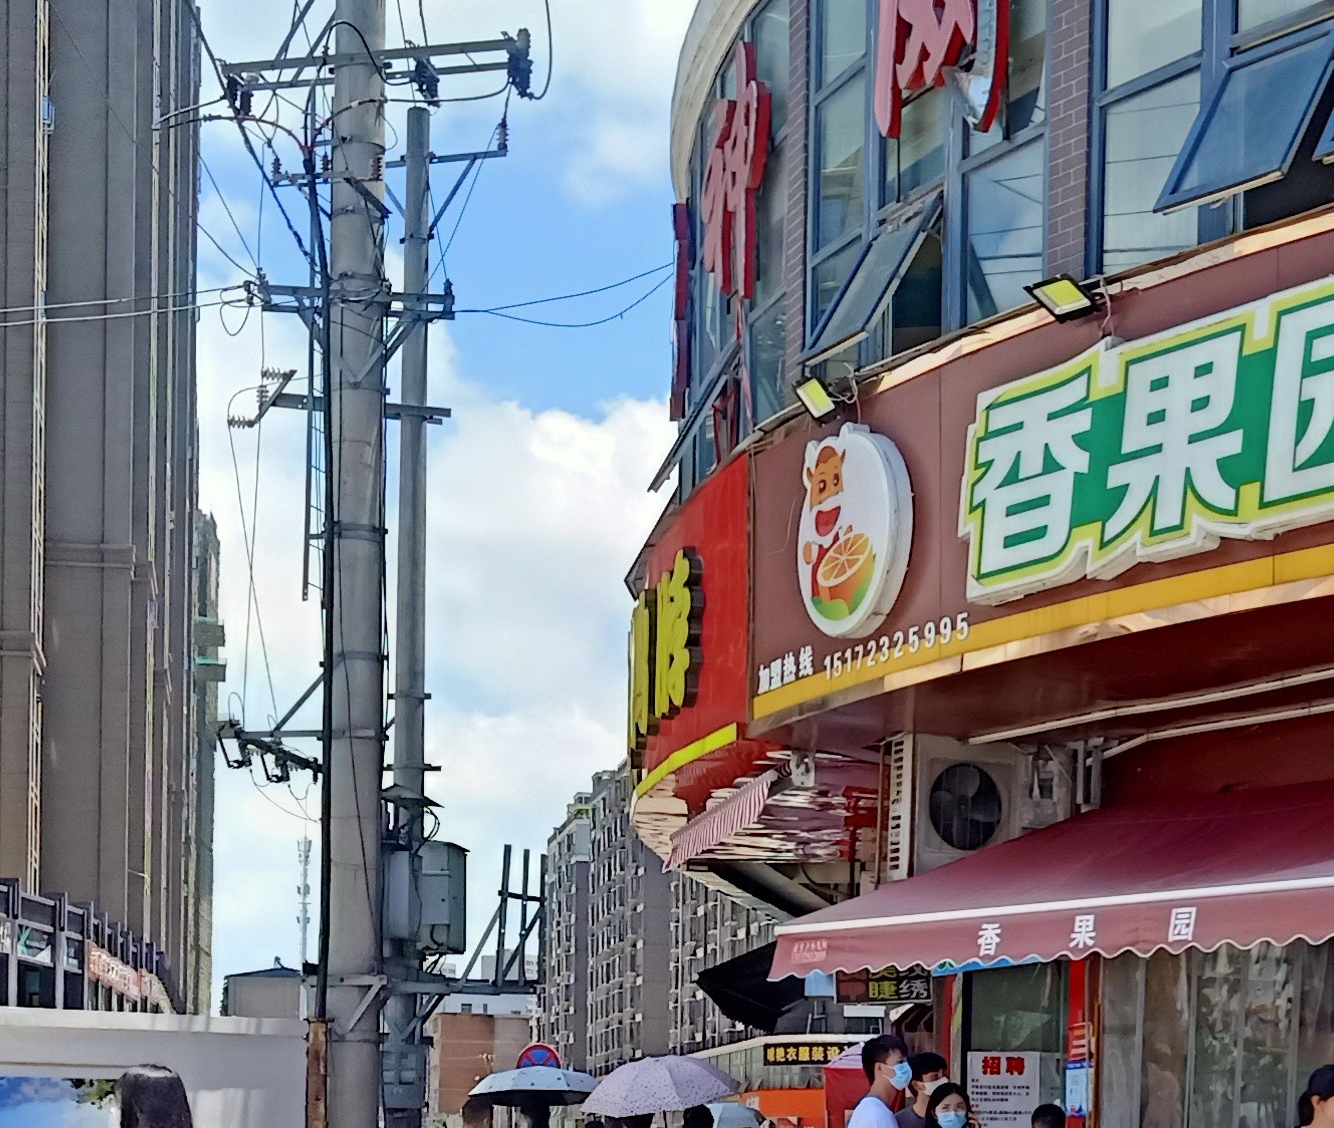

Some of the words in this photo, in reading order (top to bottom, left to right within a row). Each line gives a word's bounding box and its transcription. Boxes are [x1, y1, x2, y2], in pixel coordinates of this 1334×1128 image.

[757, 645, 815, 694] 加盟热线
[824, 612, 970, 680] 15172325995
[976, 907, 1197, 957] 香果园
[982, 1056, 1025, 1075] 招聘
